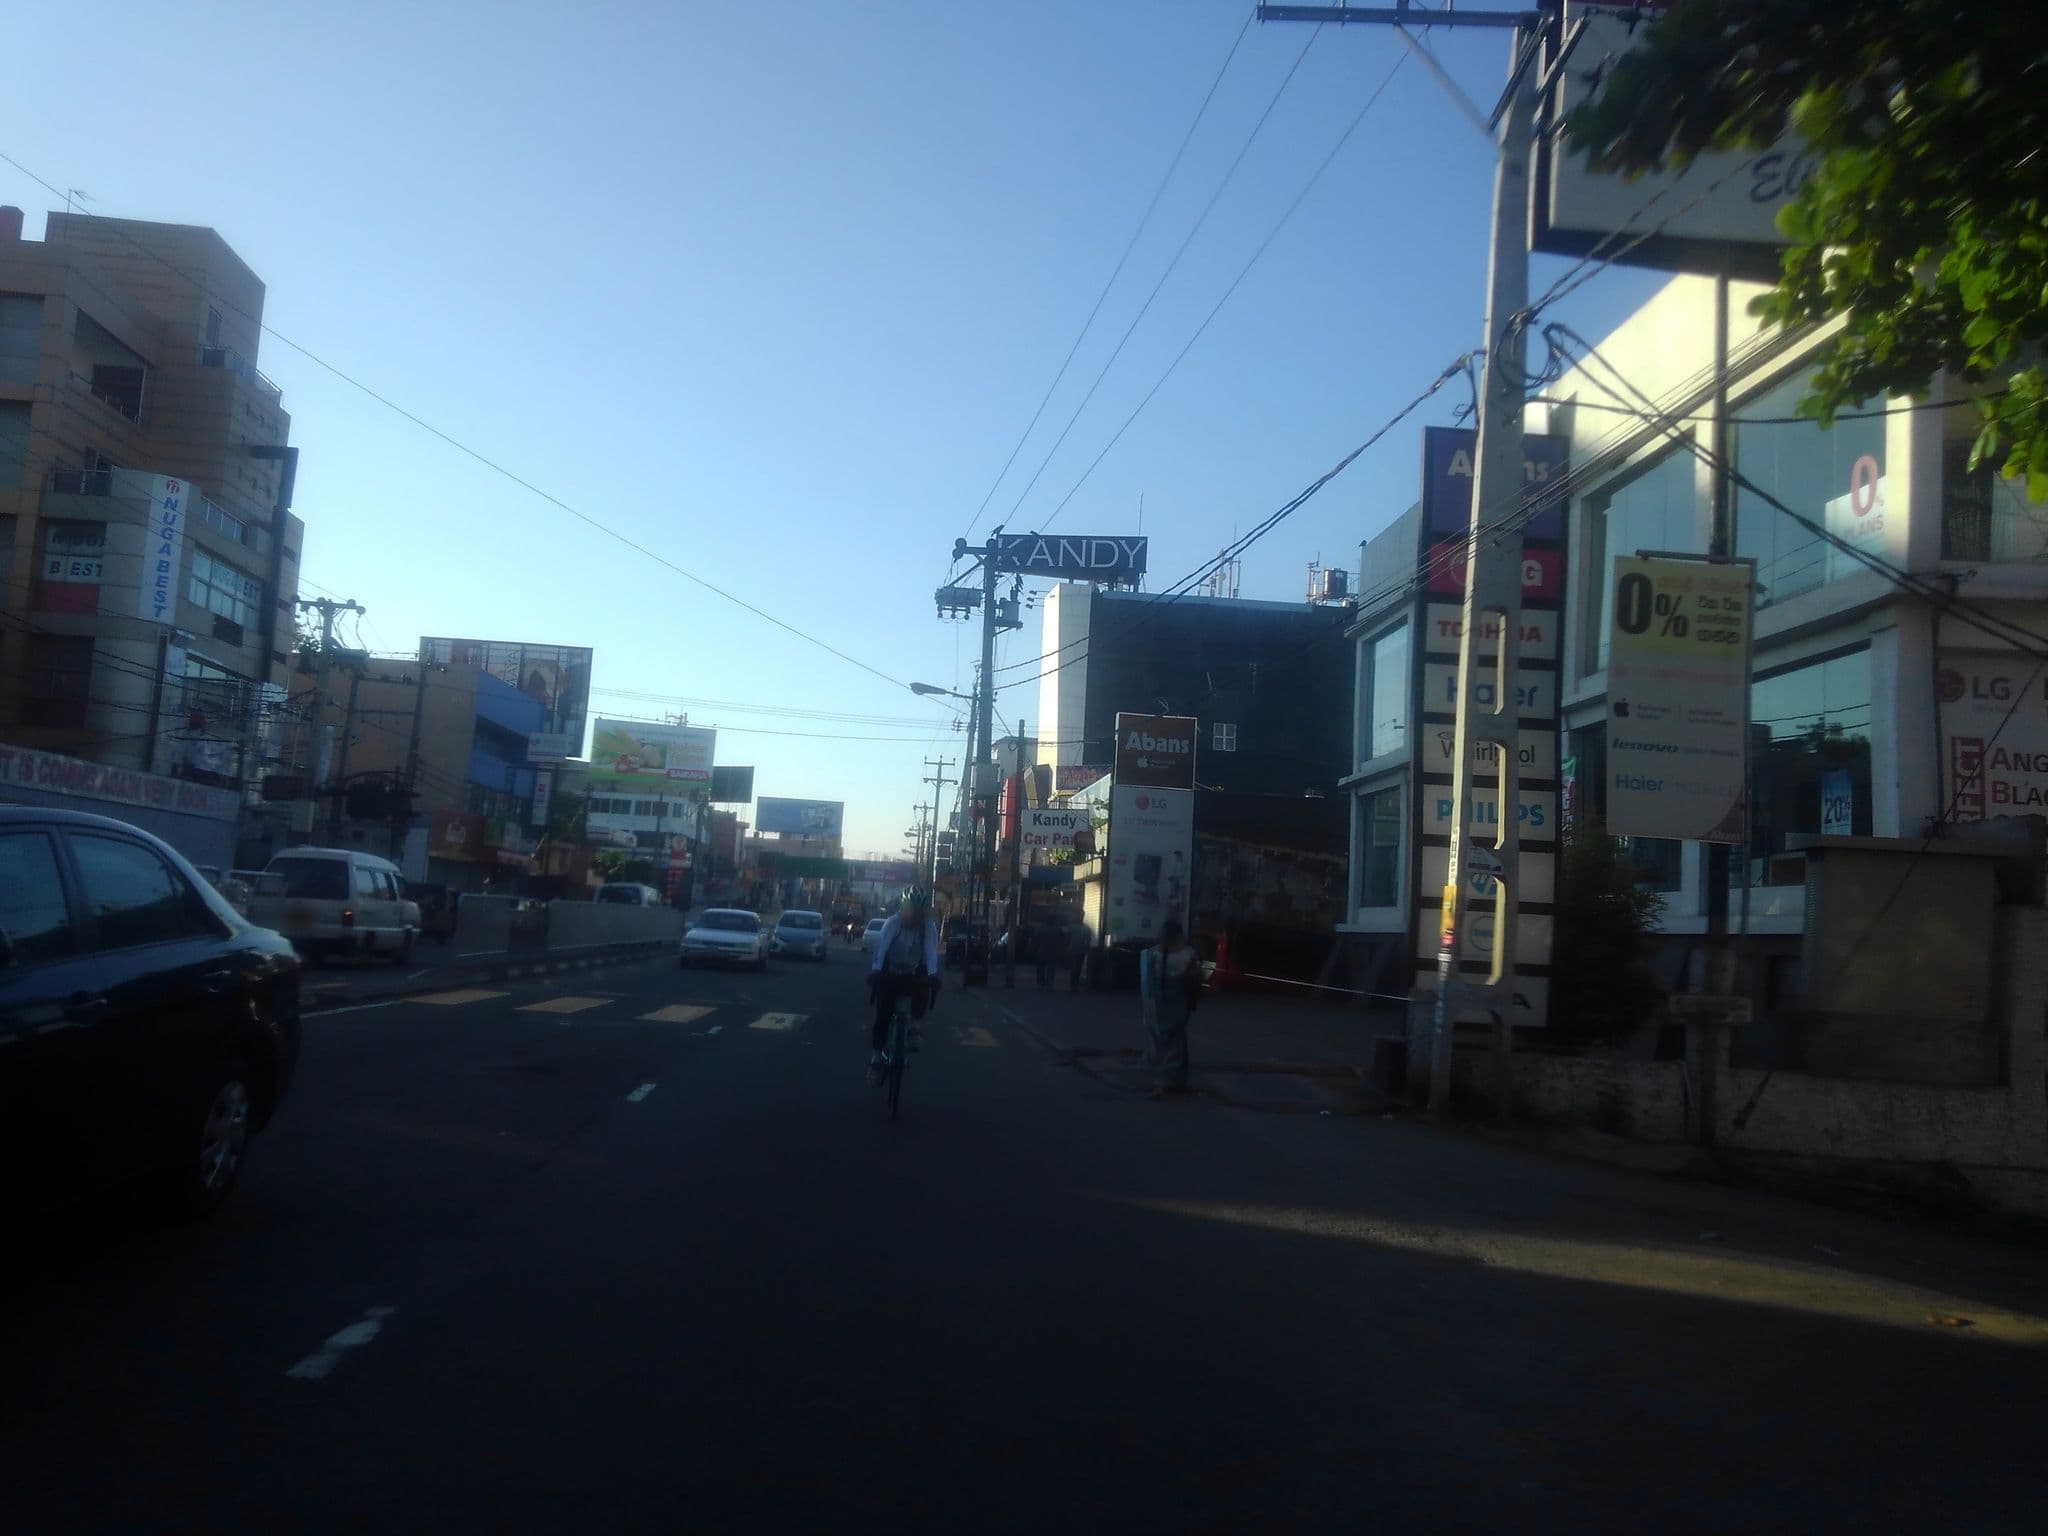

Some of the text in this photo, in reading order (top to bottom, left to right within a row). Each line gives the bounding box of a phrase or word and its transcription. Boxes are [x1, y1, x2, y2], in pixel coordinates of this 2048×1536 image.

[1617, 573, 1690, 638] 0%
[1972, 676, 2011, 701] LG
[1125, 731, 1189, 754] Abans
[1615, 773, 1665, 792] Haier
[1032, 813, 1077, 830] Kandy
[1024, 832, 1049, 846] Car
